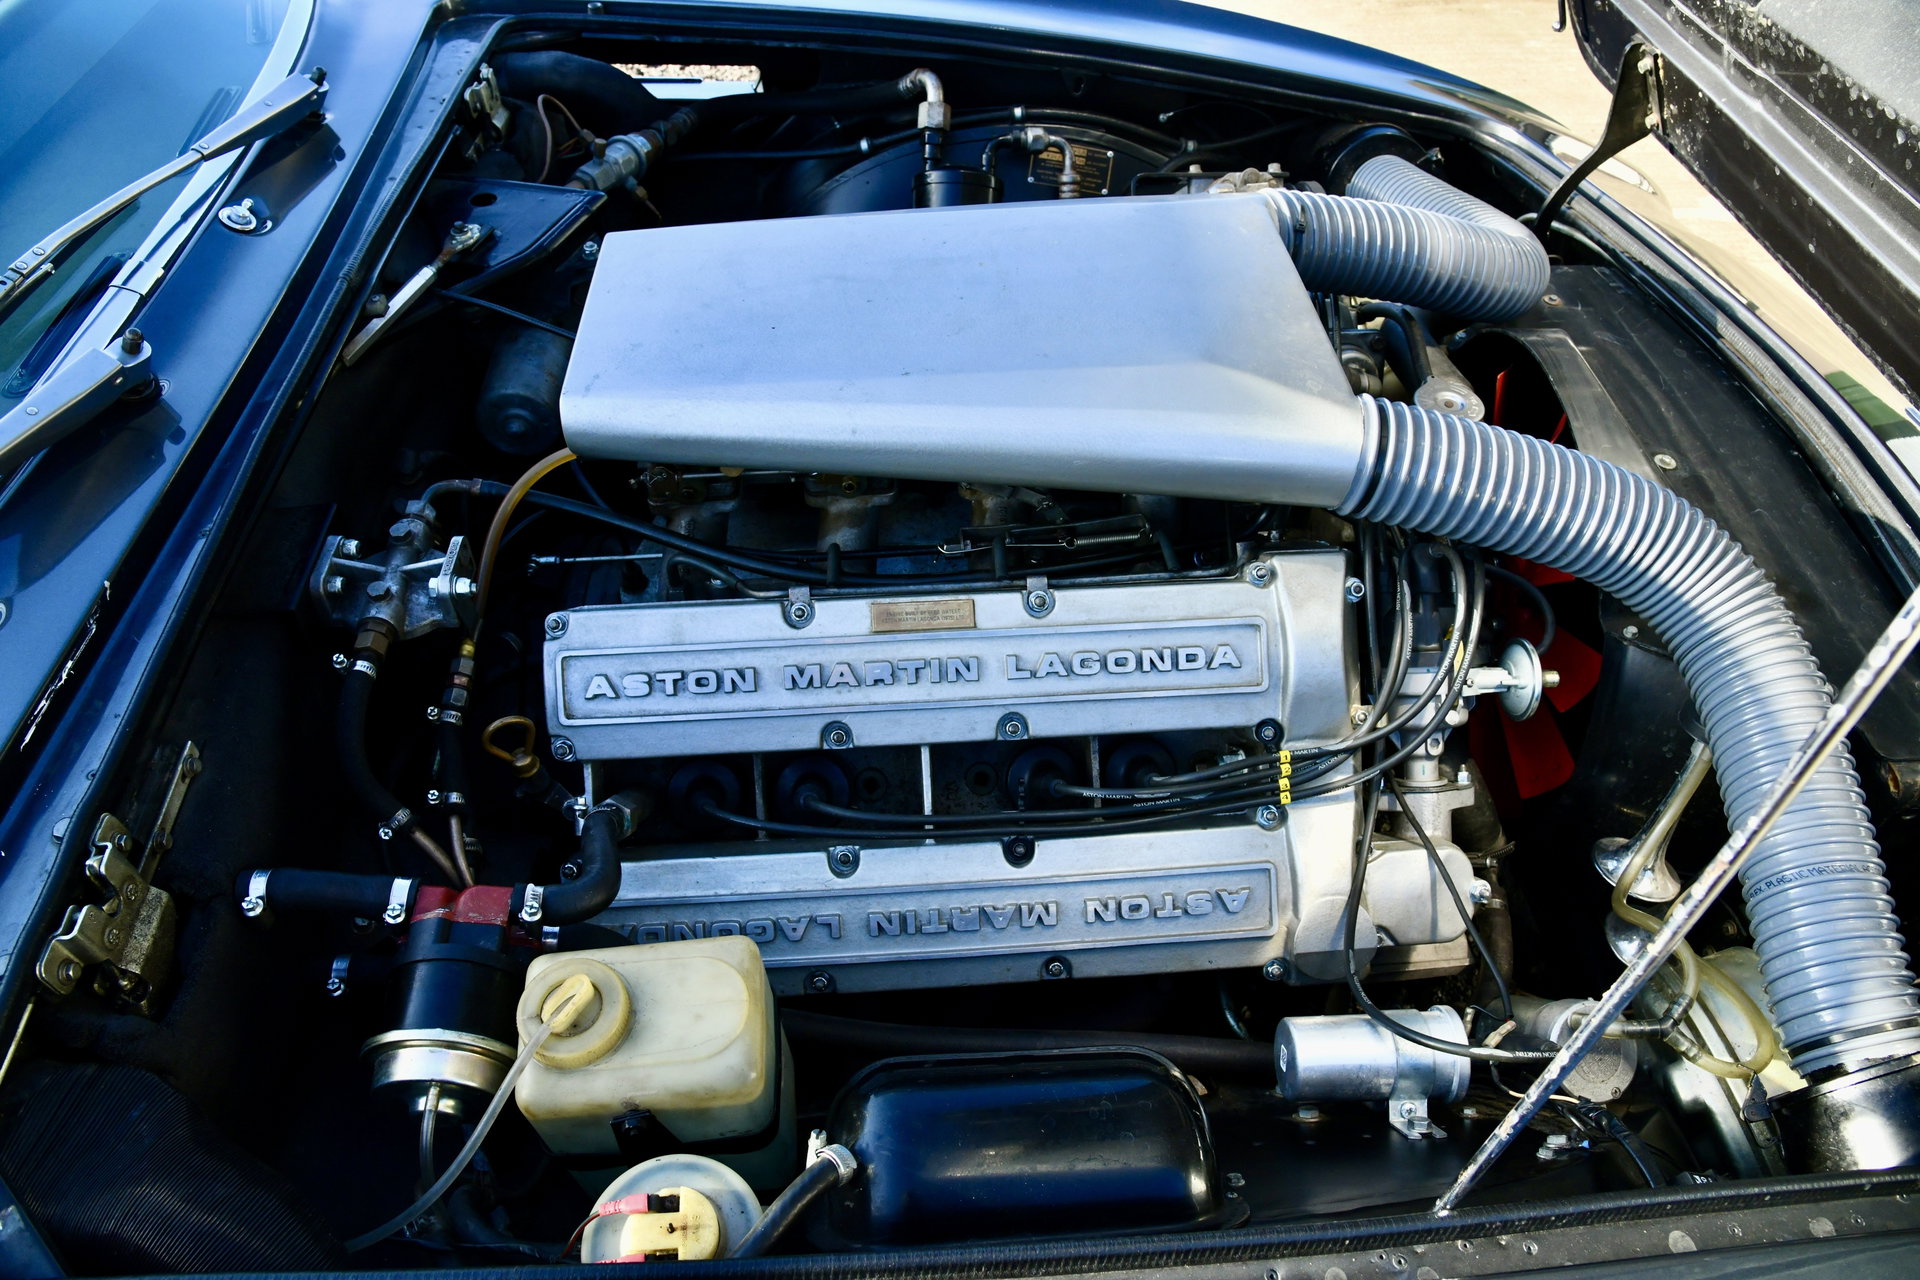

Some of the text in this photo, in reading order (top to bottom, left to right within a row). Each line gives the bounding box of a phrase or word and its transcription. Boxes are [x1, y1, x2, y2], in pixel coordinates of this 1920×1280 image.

[584, 643, 1242, 700] ASTON MARTIN LAGONDA
[1439, 631, 1460, 680] ASTON MARTIN
[1454, 668, 1466, 692] ASTON
[867, 900, 1059, 938] MARTIN
[1084, 886, 1251, 924] ASTON
